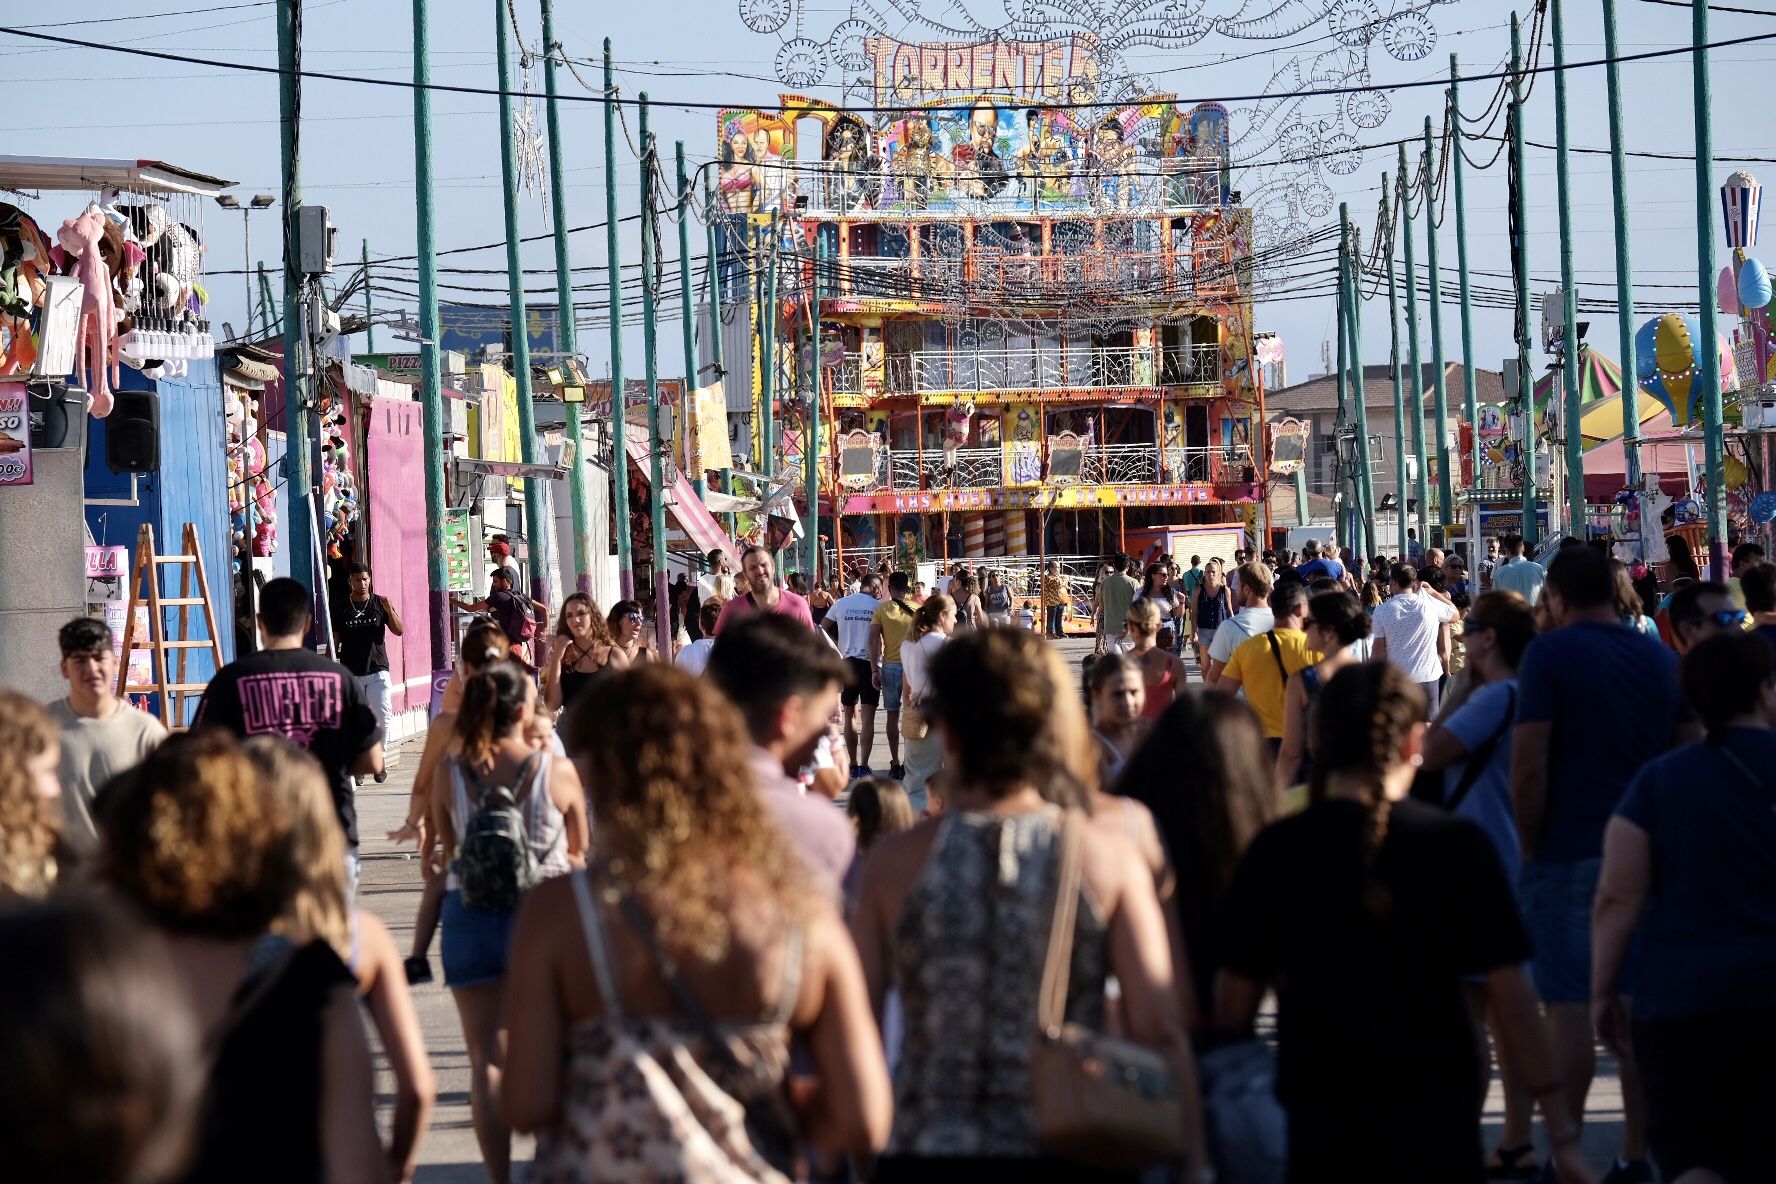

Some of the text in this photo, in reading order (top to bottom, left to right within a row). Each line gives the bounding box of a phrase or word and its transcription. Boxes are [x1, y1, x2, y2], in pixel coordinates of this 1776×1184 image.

[864, 37, 1064, 108] TORRENTE
[388, 356, 421, 369] PIZZ
[1115, 488, 1209, 504] TORRENTE
